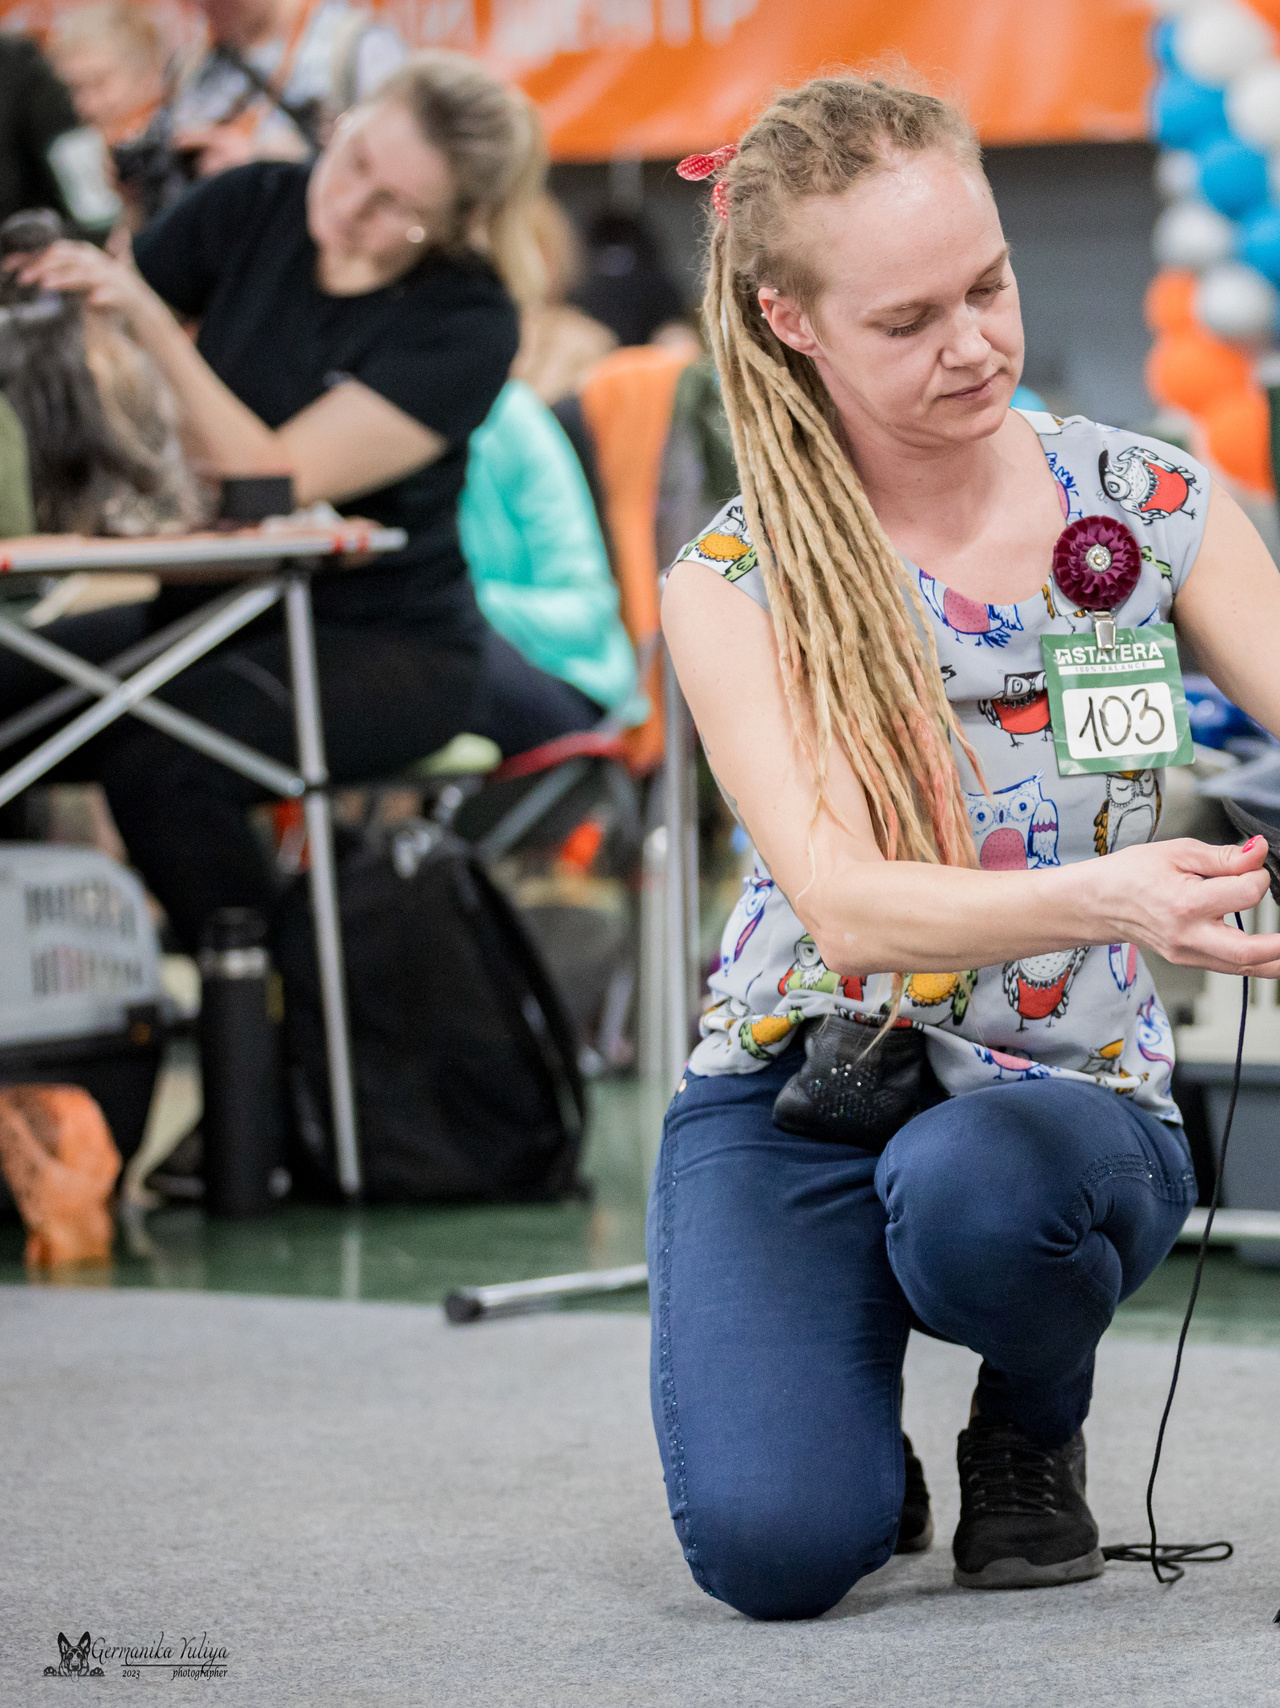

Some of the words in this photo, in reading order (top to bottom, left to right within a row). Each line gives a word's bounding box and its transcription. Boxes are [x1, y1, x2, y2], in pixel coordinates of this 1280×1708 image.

[1072, 641, 1163, 664] STATERA
[1075, 665, 1097, 673] 100%
[1101, 662, 1148, 672] BALANCE
[1078, 688, 1165, 752] 103
